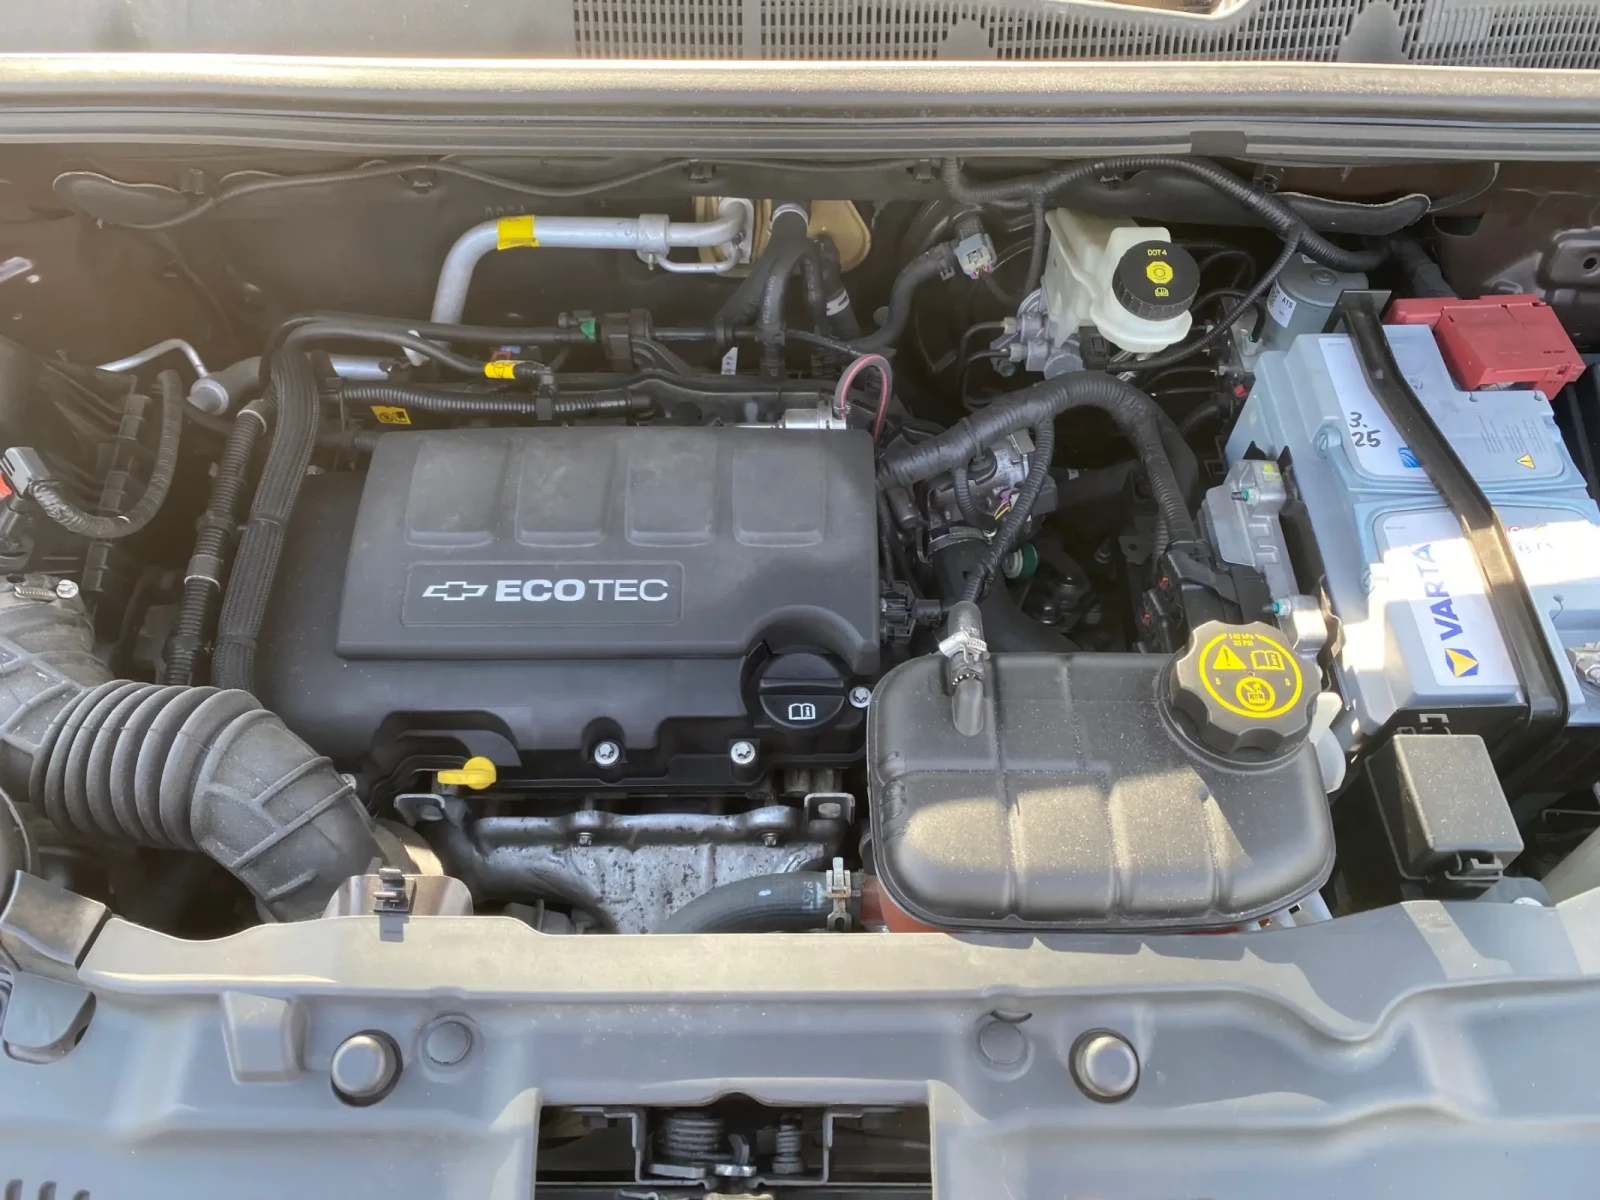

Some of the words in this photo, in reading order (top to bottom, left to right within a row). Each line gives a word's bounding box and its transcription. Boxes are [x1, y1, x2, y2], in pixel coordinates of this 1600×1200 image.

[1351, 429, 1381, 448] 25
[495, 579, 669, 602] ECOTEC
[1412, 543, 1464, 642] VARTA
